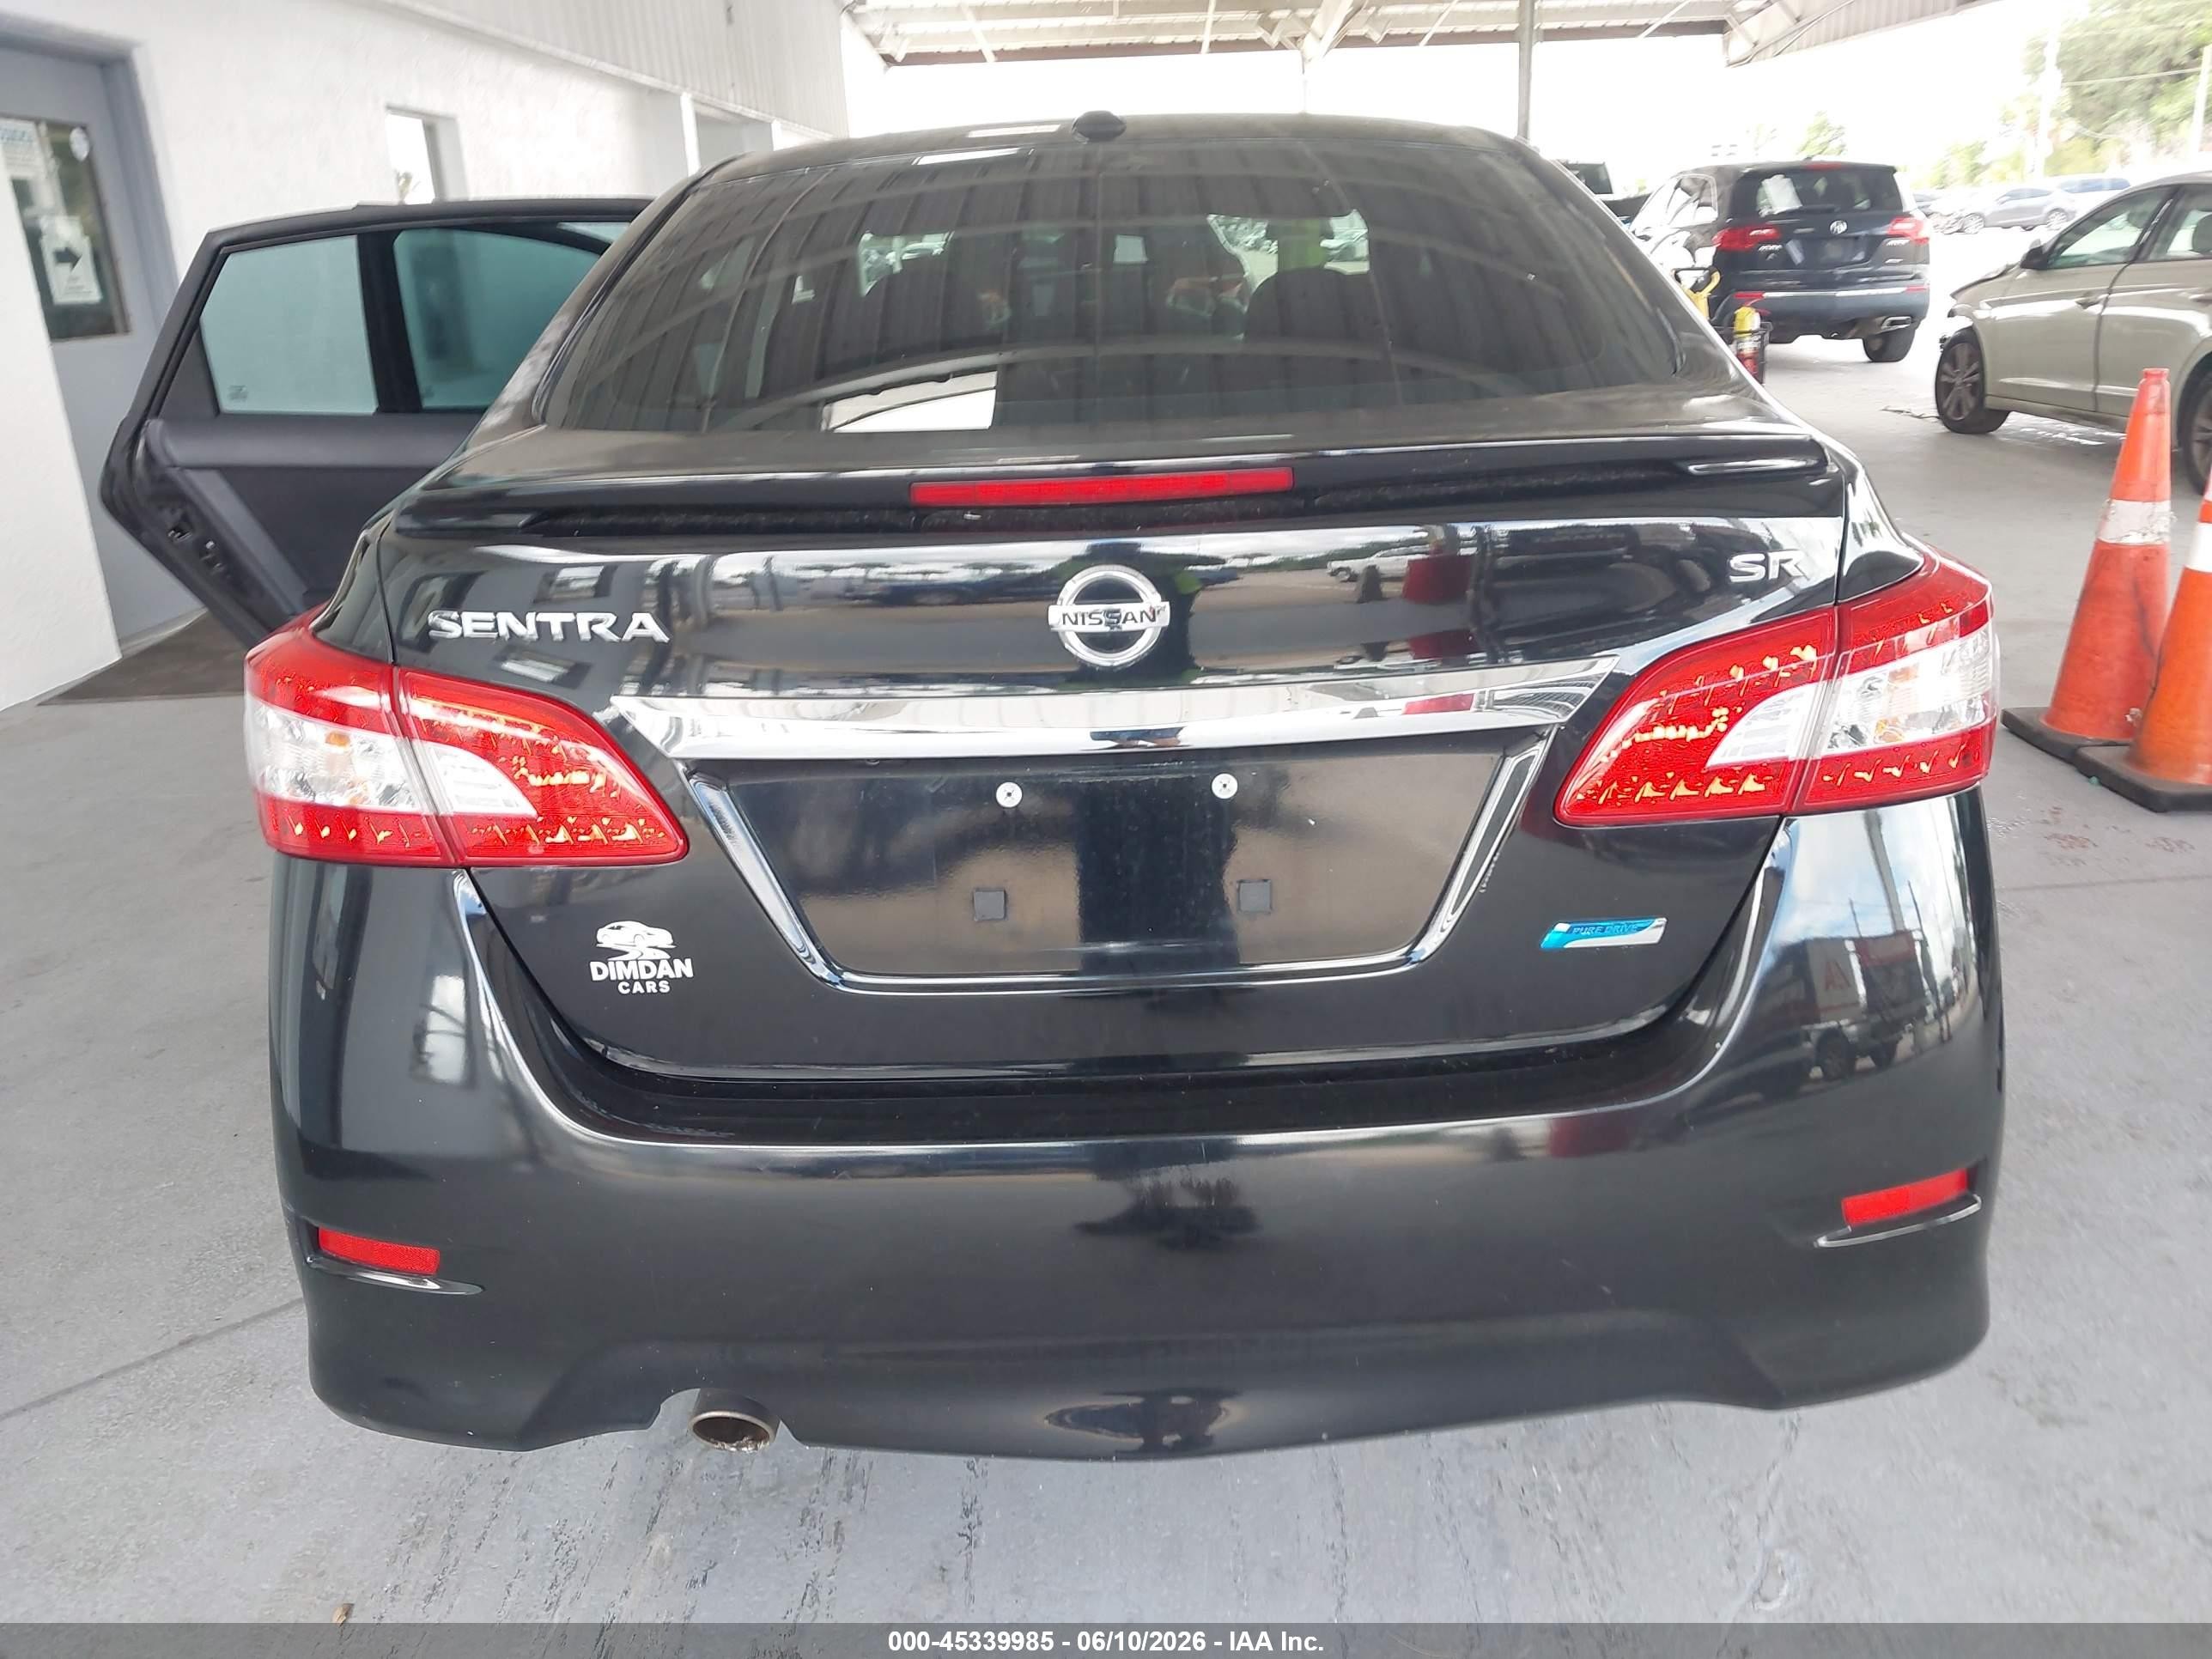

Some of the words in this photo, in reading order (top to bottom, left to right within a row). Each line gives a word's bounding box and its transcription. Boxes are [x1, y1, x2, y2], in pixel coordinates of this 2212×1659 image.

[1728, 550, 1808, 582] SR
[428, 610, 670, 643] SENTRA
[1061, 608, 1157, 626] NISSAN
[1571, 926, 1603, 935] PURE
[1604, 923, 1638, 934] DRIVE
[589, 957, 695, 981] DIMDAN
[617, 980, 672, 994] CARS
